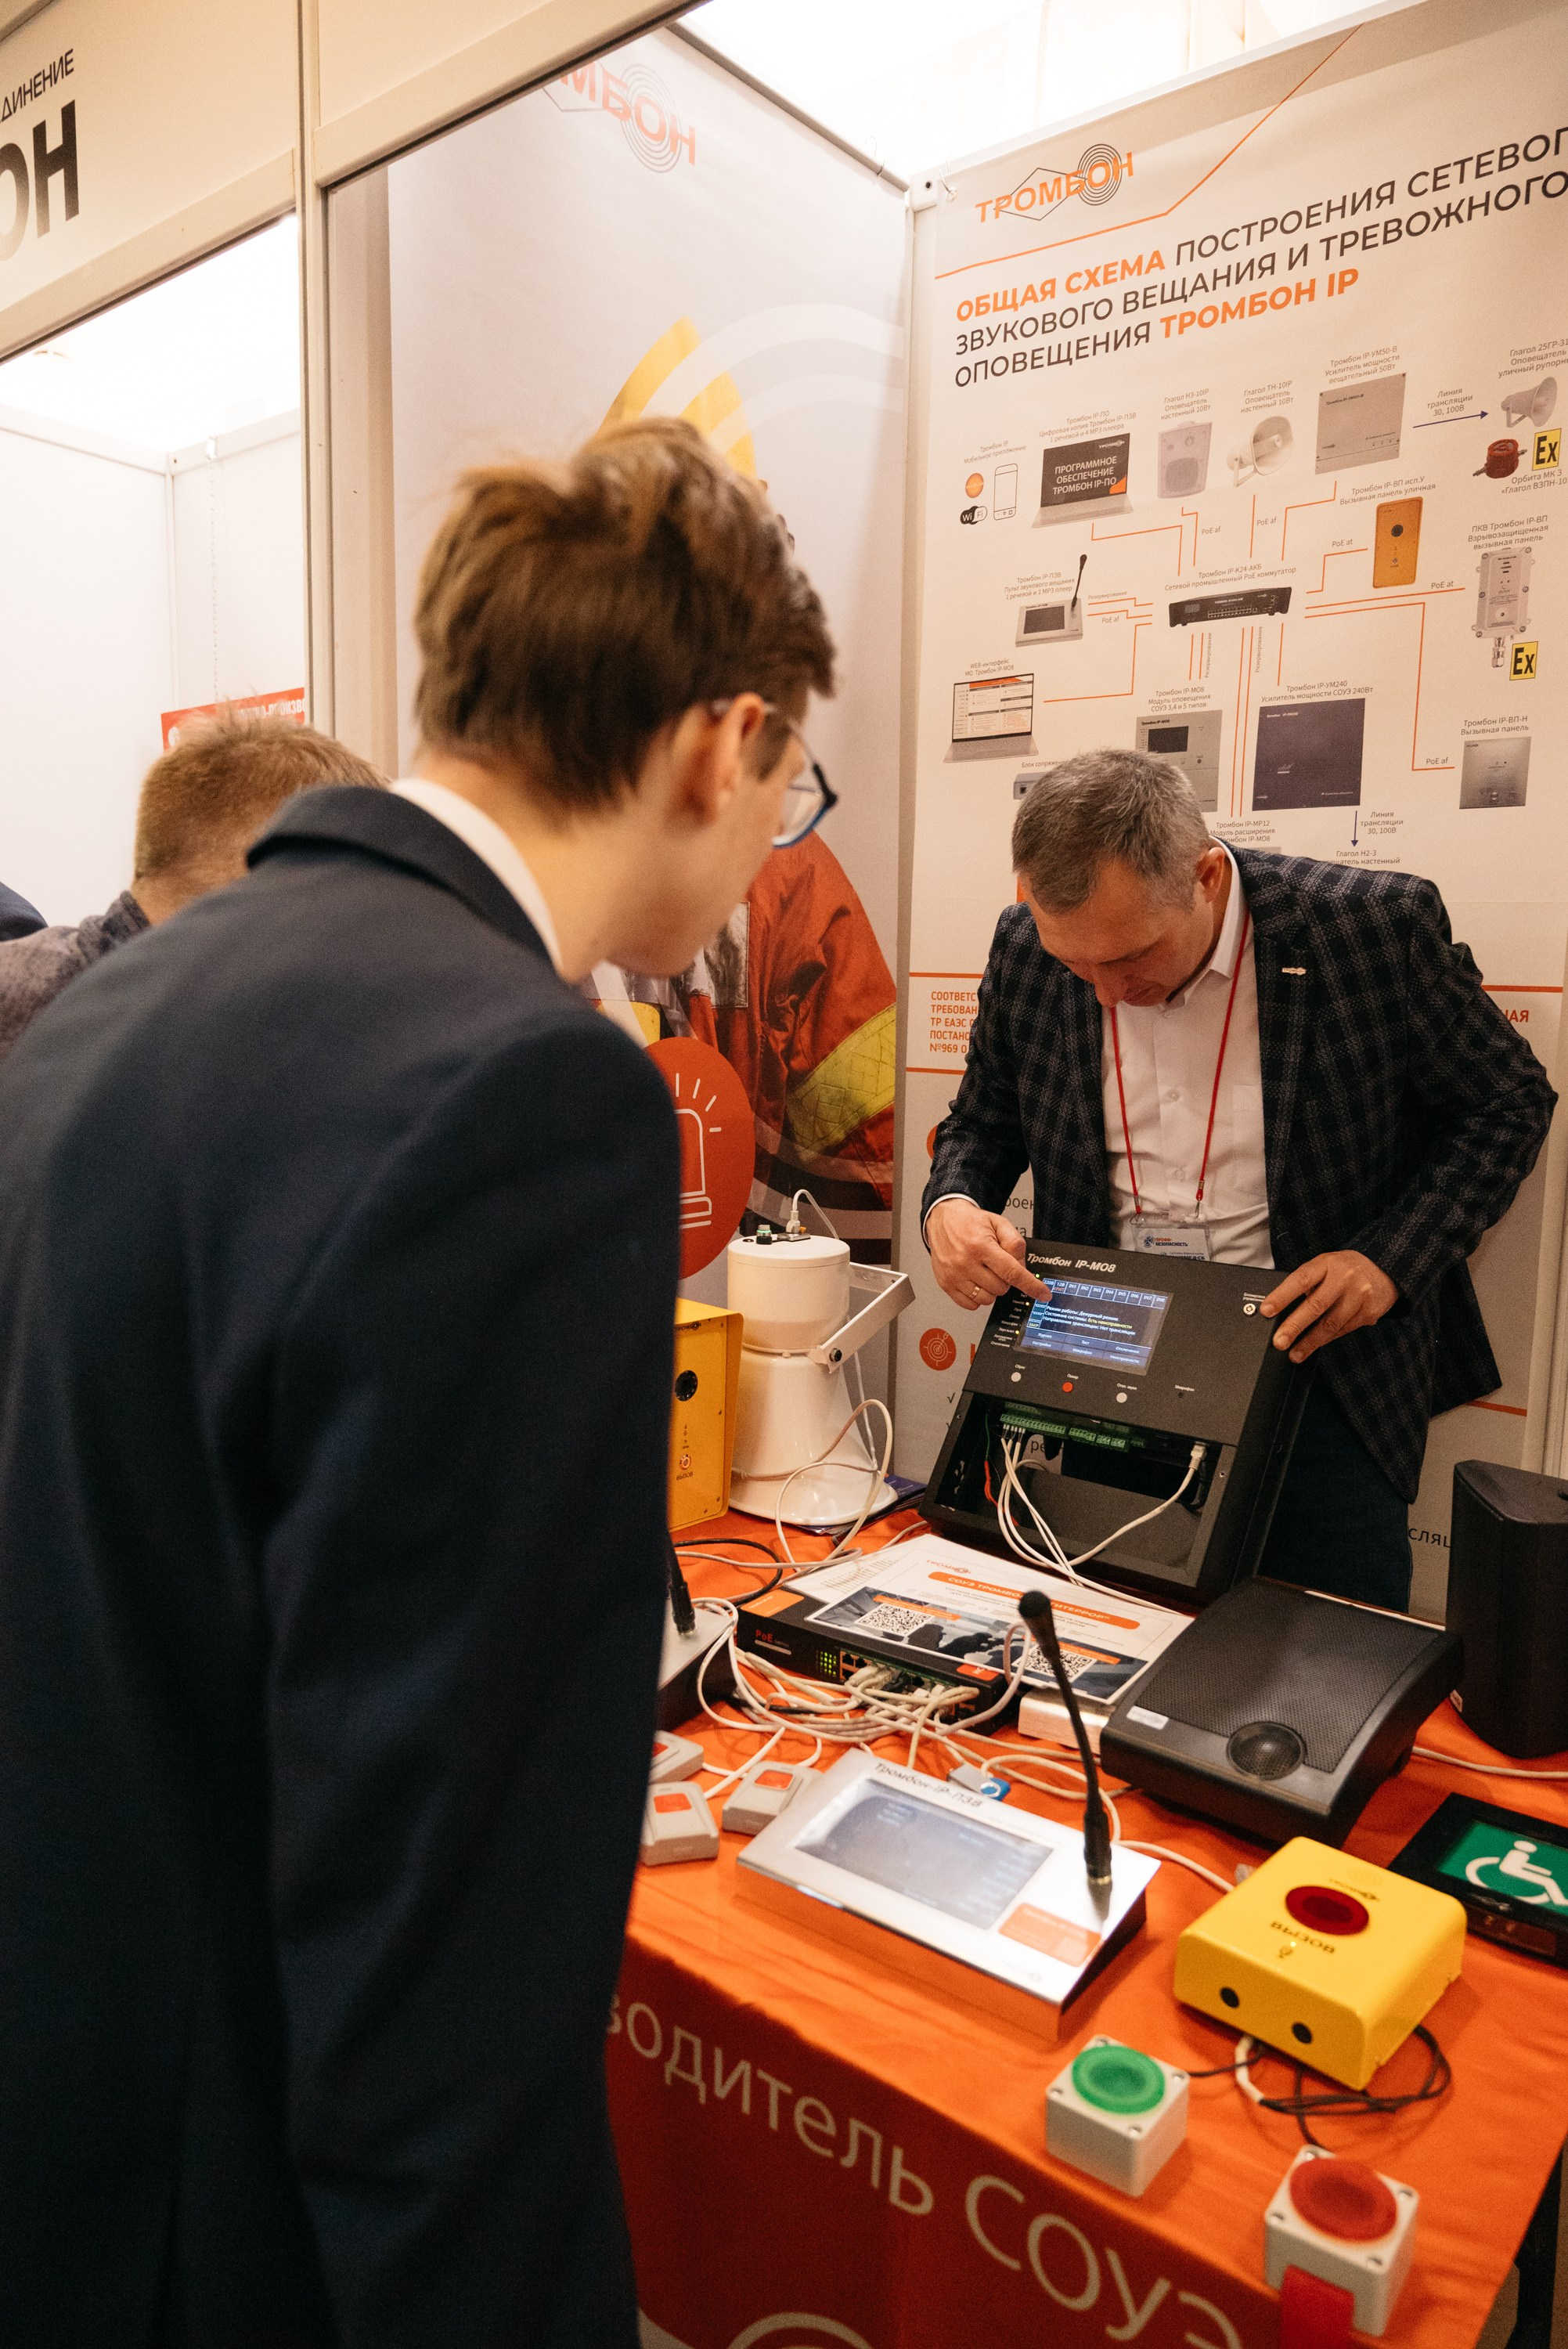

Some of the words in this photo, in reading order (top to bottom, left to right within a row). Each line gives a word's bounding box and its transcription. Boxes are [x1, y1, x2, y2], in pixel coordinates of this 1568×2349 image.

[559, 59, 695, 166] МБОН
[975, 151, 1134, 224] ТРОМБОН
[956, 276, 1056, 323] ОБЩАЯ
[1065, 250, 1166, 294] СХЕМА
[1175, 180, 1396, 265] ПОСТРОЕНИЯ
[956, 298, 1112, 355] ЗВУКОВОГО
[1123, 253, 1276, 315] ВЕЩАНИЯ
[1286, 244, 1309, 271] И
[1321, 170, 1568, 262] ТРЕВОЖНОГО
[955, 323, 1151, 388] ОПОВЕЩЕНИЯ
[1159, 279, 1315, 339] ТРОМБОН
[1326, 266, 1360, 295] IP
[1509, 346, 1536, 357] Глагол
[1511, 348, 1566, 366] Оповещатель
[1325, 365, 1361, 377] Усилитель
[1363, 354, 1400, 368] мощности
[1330, 355, 1361, 367] Тромбон
[1328, 368, 1378, 384] вещательный
[1379, 363, 1396, 373] 50Вт
[1498, 363, 1535, 378] уличный
[1244, 387, 1265, 397] Глагол
[1245, 391, 1290, 405] Оповещатель
[1437, 388, 1462, 399] Линия
[1164, 395, 1184, 405] Глагол
[1164, 399, 1208, 412] Оповещатель
[1240, 401, 1278, 413] настенный
[1427, 395, 1473, 410] трансляции
[1160, 409, 1195, 420] настенный
[1447, 404, 1465, 415] 100В
[1066, 414, 1092, 424] Тромбон
[1039, 427, 1069, 438] Цифровая
[1069, 423, 1088, 433] копия
[1090, 417, 1116, 428] Тромбон
[1535, 435, 1559, 466] Ex
[1054, 455, 1117, 474] ПРОГРАММНОЕ
[1056, 467, 1115, 485] ОБЕСПЕЧЕНИЕ
[1512, 474, 1542, 485] Орбита
[1053, 481, 1094, 495] ТРОМБОН
[1094, 476, 1116, 488] IP-ПО
[1352, 485, 1382, 496] Тромбон
[1339, 493, 1376, 505] Вызывная
[1377, 489, 1403, 500] панель
[1404, 484, 1436, 496] уличная
[1472, 524, 1488, 533] ПКВ
[1490, 519, 1526, 532] Тромбон
[1468, 524, 1548, 543] Взрывозащищенная
[1473, 539, 1512, 550] вызывная
[1514, 535, 1543, 547] панель
[1017, 574, 1041, 584] Тромбон
[1165, 582, 1190, 591] Сетевой
[1191, 574, 1243, 589] промышленный
[1256, 567, 1296, 579] коммутатор
[1199, 568, 1226, 579] Тромбон
[1512, 647, 1534, 676] Ex
[1155, 689, 1182, 698] Тромбон
[1286, 683, 1316, 692] Тромбон
[1148, 697, 1170, 706] Модуль
[1171, 693, 1211, 704] оповещения
[1261, 694, 1296, 702] Усилитель
[1296, 691, 1332, 700] мощности
[1188, 702, 1206, 710] типов
[1461, 727, 1499, 736] Вызывная
[1501, 724, 1530, 733] панель
[1464, 718, 1497, 728] Тромбон
[1361, 819, 1404, 828] трансляции
[1235, 827, 1275, 837] расширения
[931, 1017, 941, 1027] ТР
[944, 1017, 967, 1028] ЕАЭС
[930, 1043, 957, 1054] №969
[1026, 1254, 1072, 1268] Тромбон
[977, 1584, 1022, 1599] ТРОМБО
[755, 1629, 773, 1644] PoE
[874, 1761, 930, 1788] Тромбон
[1270, 1921, 1336, 1954] ВЫЗОВ
